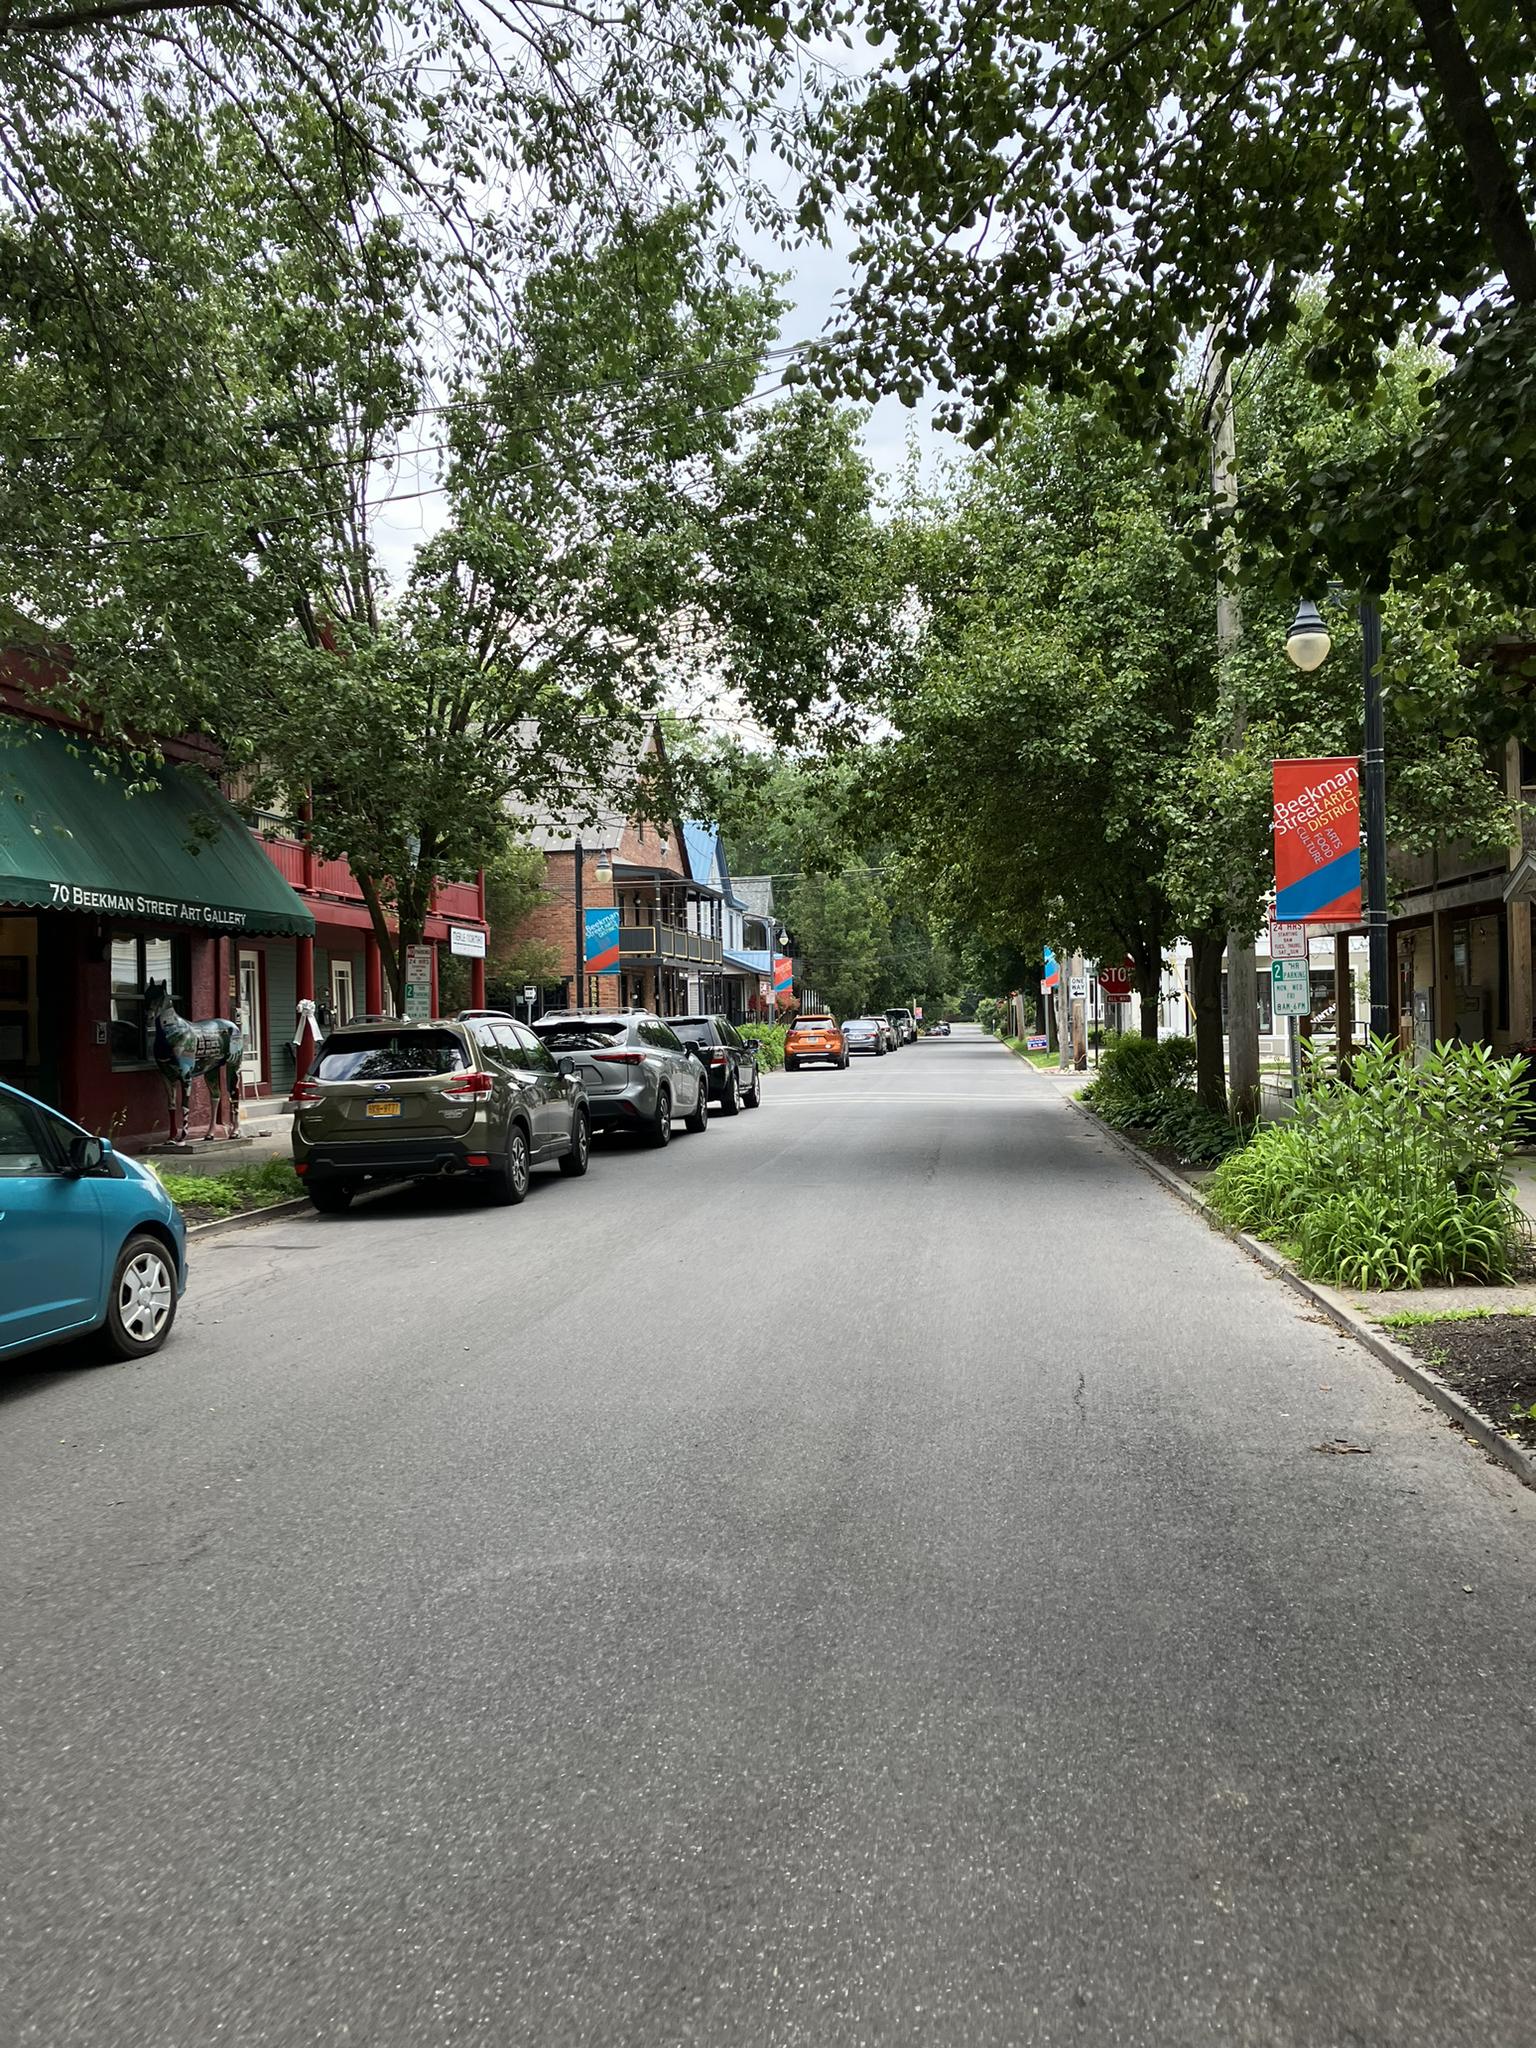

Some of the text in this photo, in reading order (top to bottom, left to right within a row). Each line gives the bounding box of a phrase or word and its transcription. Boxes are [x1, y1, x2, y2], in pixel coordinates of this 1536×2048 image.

[1274, 767, 1359, 820] Beekman
[1274, 786, 1353, 835] Street ARTS
[1307, 796, 1359, 832] DISTRICT
[1296, 826, 1324, 864] CULTURE
[1314, 832, 1334, 858] FOOD
[1324, 828, 1343, 849] ARTS
[50, 884, 247, 926] 70 BEEKMAN STREET ART GALLERY
[585, 911, 620, 932] Beekman
[1273, 923, 1283, 931] 24
[1274, 965, 1281, 979] 2
[406, 985, 414, 997] 2
